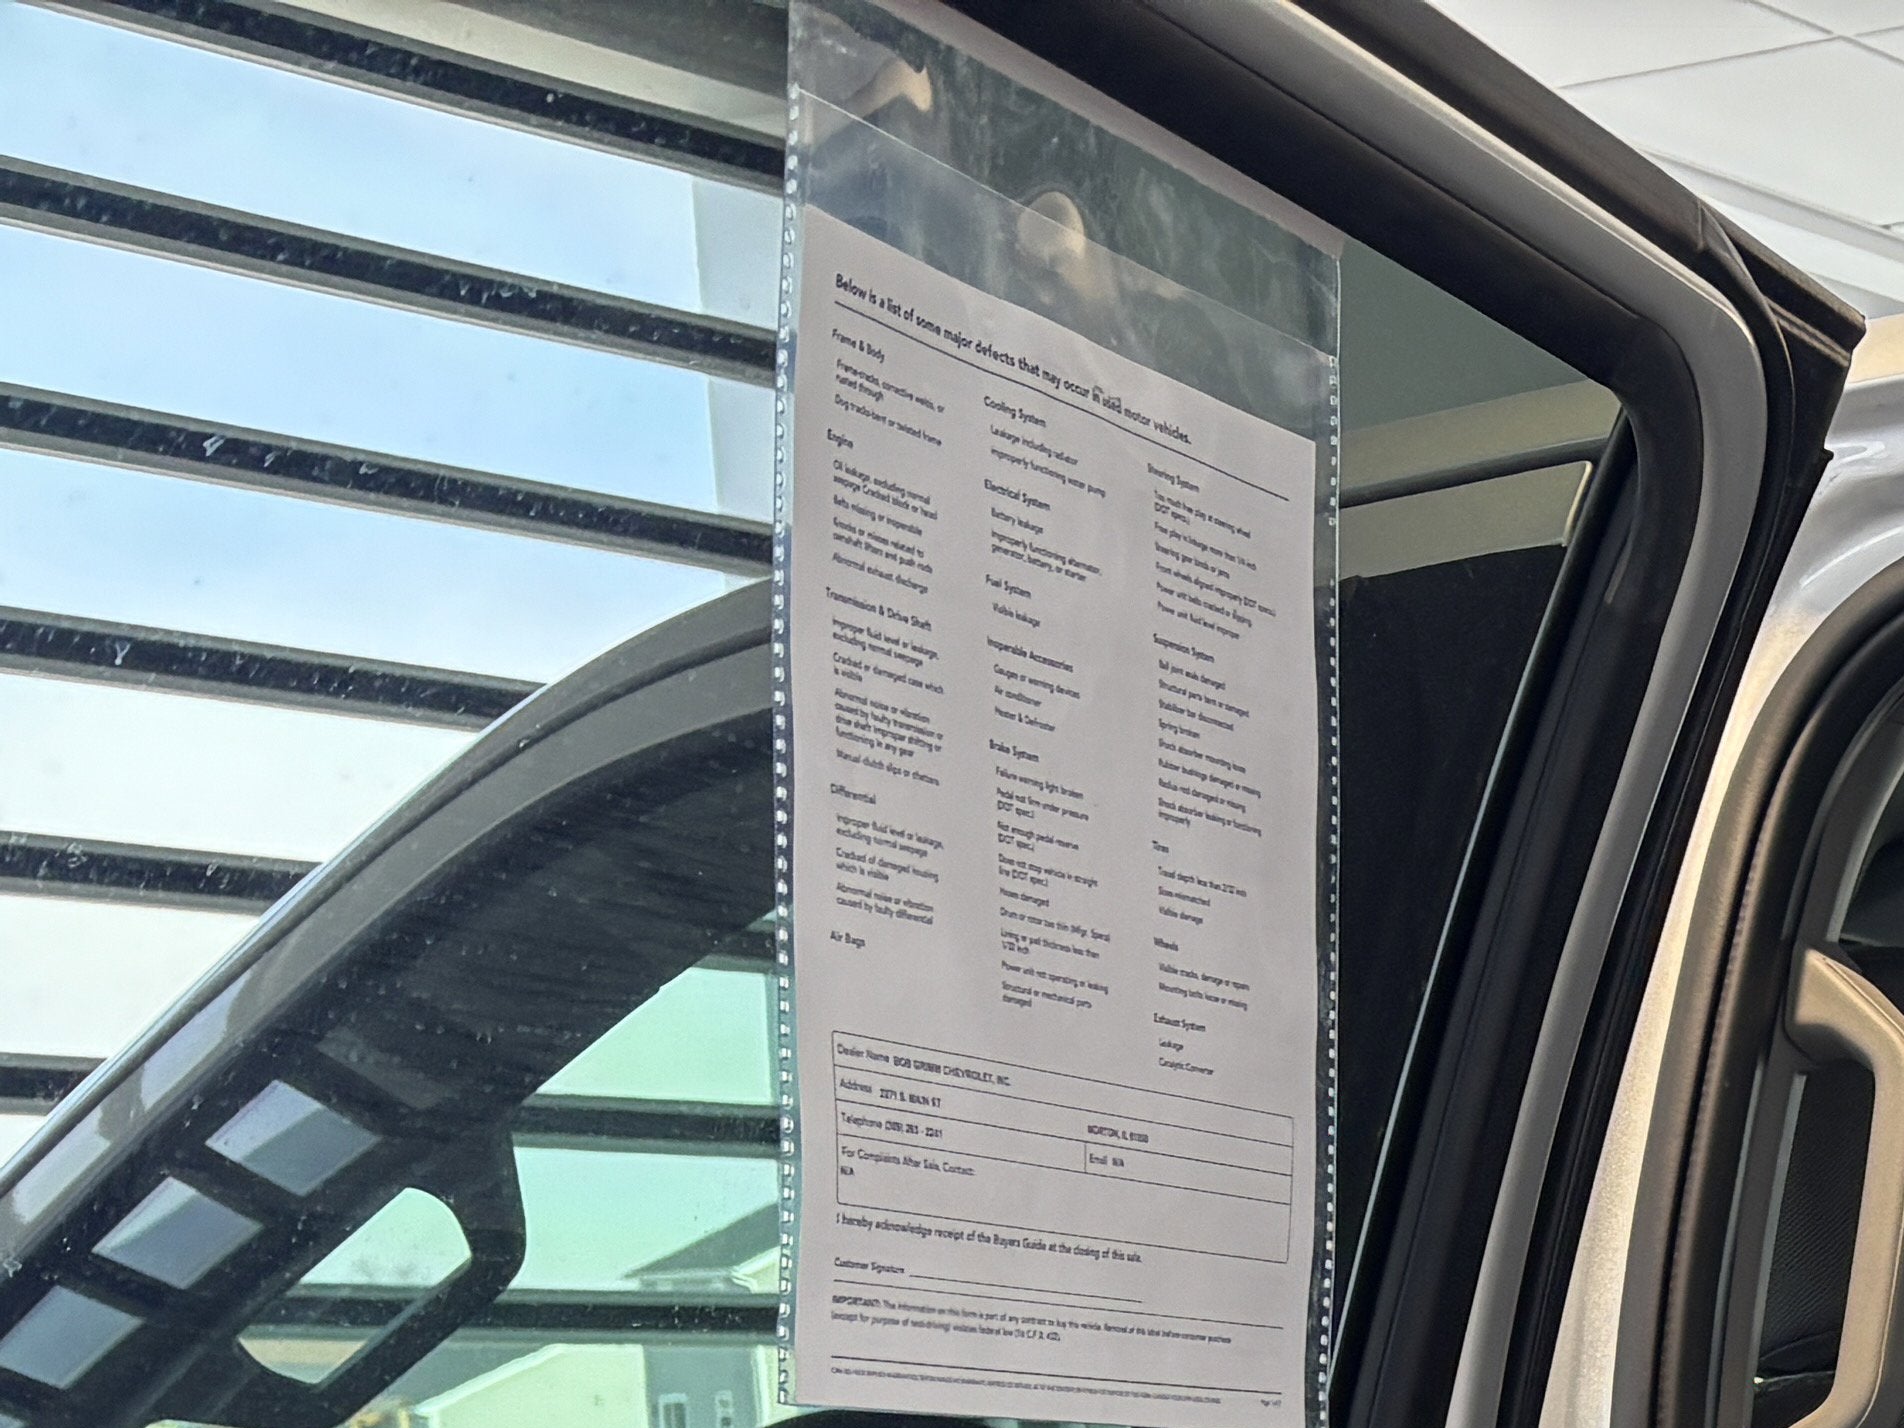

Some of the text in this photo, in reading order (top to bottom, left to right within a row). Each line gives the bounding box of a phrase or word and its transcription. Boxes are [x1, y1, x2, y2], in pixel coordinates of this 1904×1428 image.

[835, 272, 867, 300] Below
[886, 296, 901, 318] list
[915, 315, 941, 336] some
[942, 328, 973, 349] major
[974, 339, 1015, 367] defects
[1017, 356, 1040, 377] that
[1041, 369, 1061, 390] may
[1062, 379, 1090, 398] occur
[1123, 407, 1151, 426] motor
